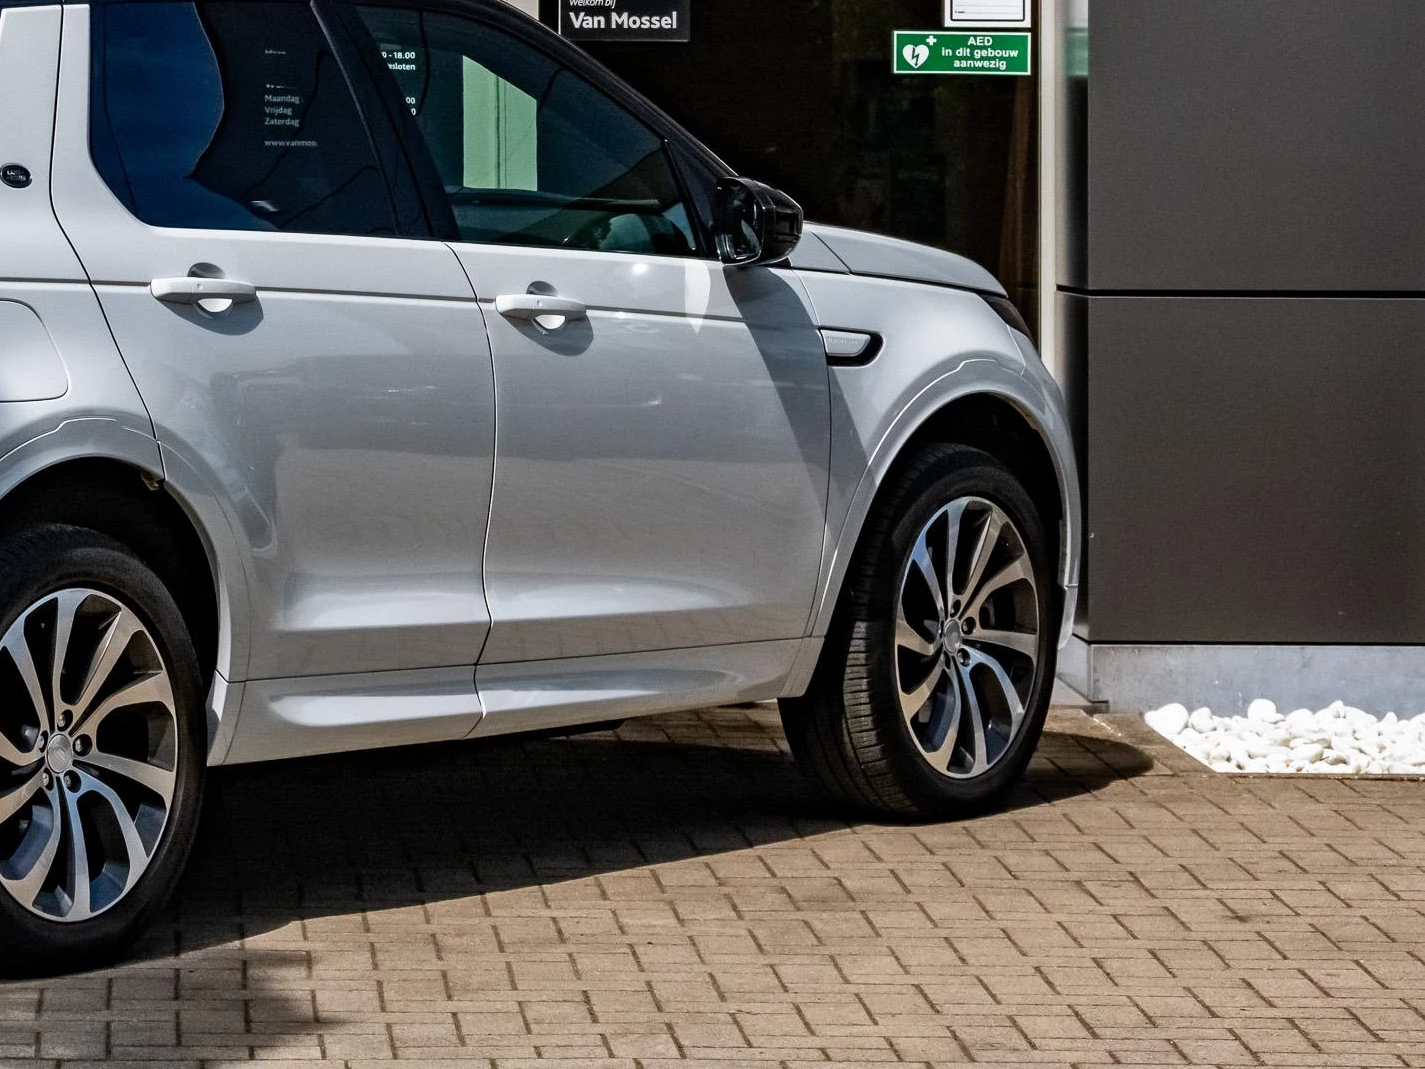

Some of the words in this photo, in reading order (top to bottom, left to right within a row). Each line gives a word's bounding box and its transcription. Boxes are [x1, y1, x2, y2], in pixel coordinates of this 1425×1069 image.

[569, 11, 606, 29] Van
[611, 11, 677, 29] Mossel
[968, 36, 993, 46] AED
[393, 51, 416, 59] 18.00
[942, 47, 952, 57] in
[956, 47, 971, 57] dit
[974, 47, 1019, 60] gebouw
[387, 62, 416, 70] esloten
[953, 59, 1007, 70] aanwezig
[265, 94, 300, 104] Maandag
[265, 117, 300, 127] Zaterdag
